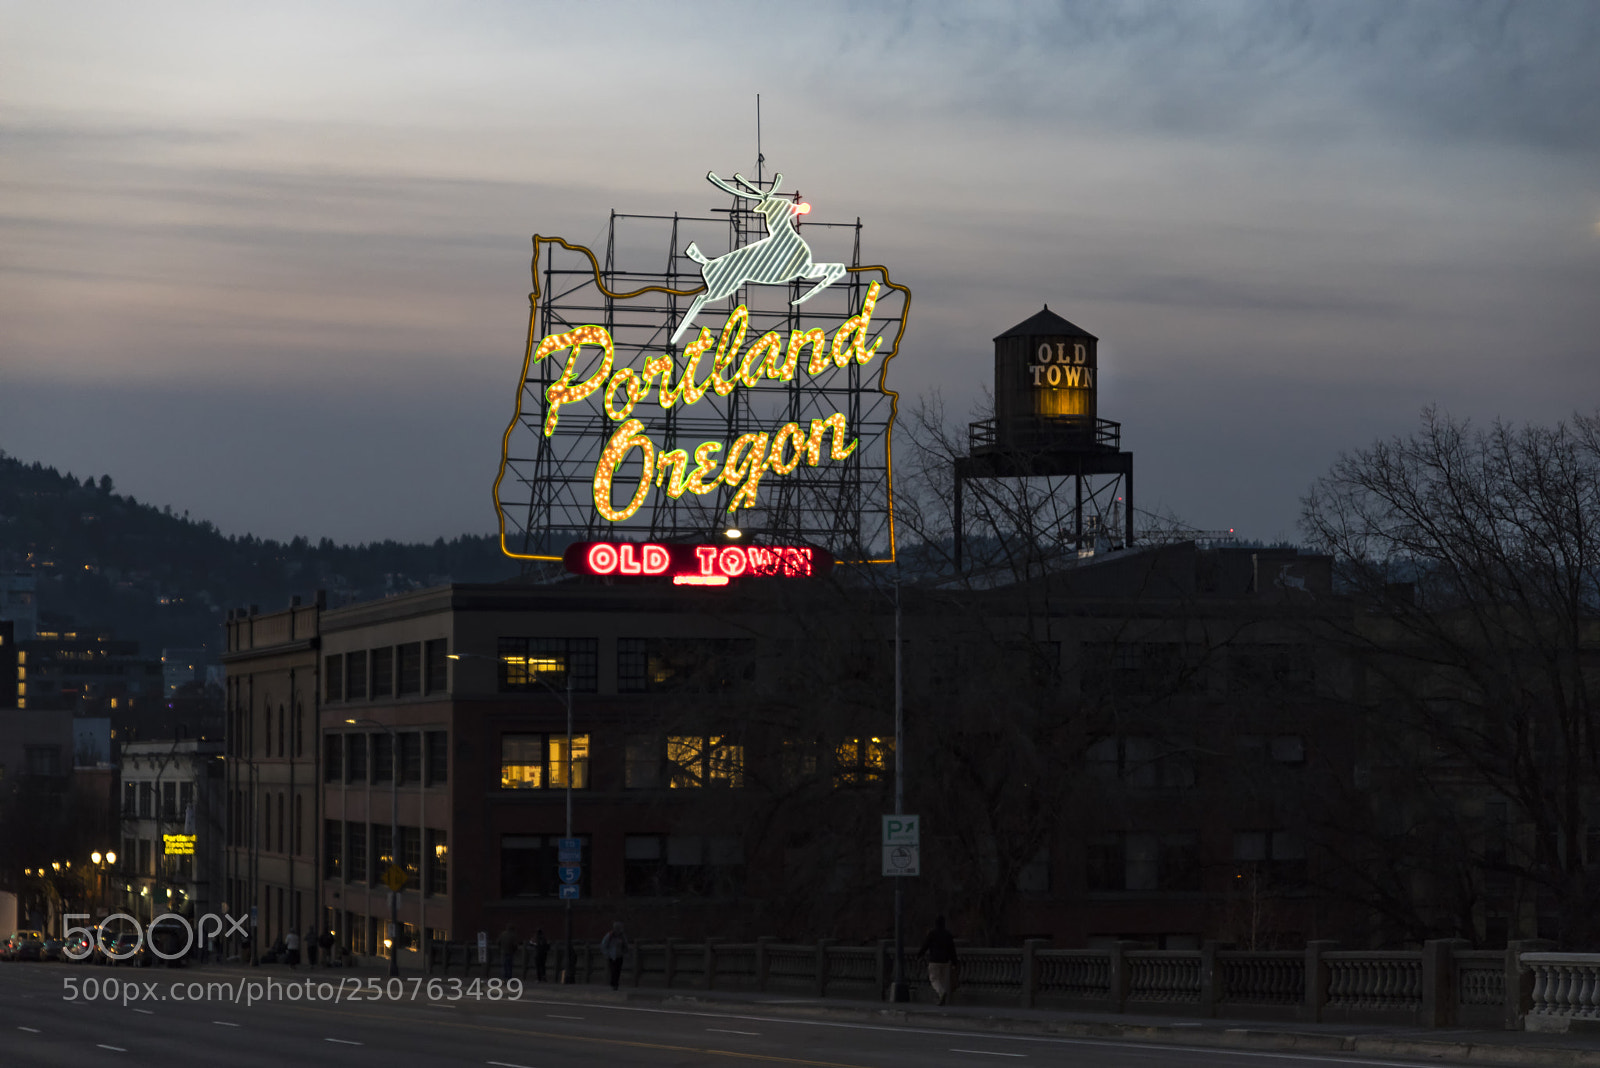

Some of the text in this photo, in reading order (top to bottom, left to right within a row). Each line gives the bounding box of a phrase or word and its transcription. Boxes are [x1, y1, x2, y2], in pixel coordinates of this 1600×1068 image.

[534, 280, 882, 437] Portland
[1038, 342, 1086, 364] OLD
[1029, 364, 1093, 388] TOWN
[593, 412, 858, 521] Oregon
[588, 543, 812, 577] OLD TOWN
[887, 820, 903, 840] P
[566, 868, 574, 881] 5
